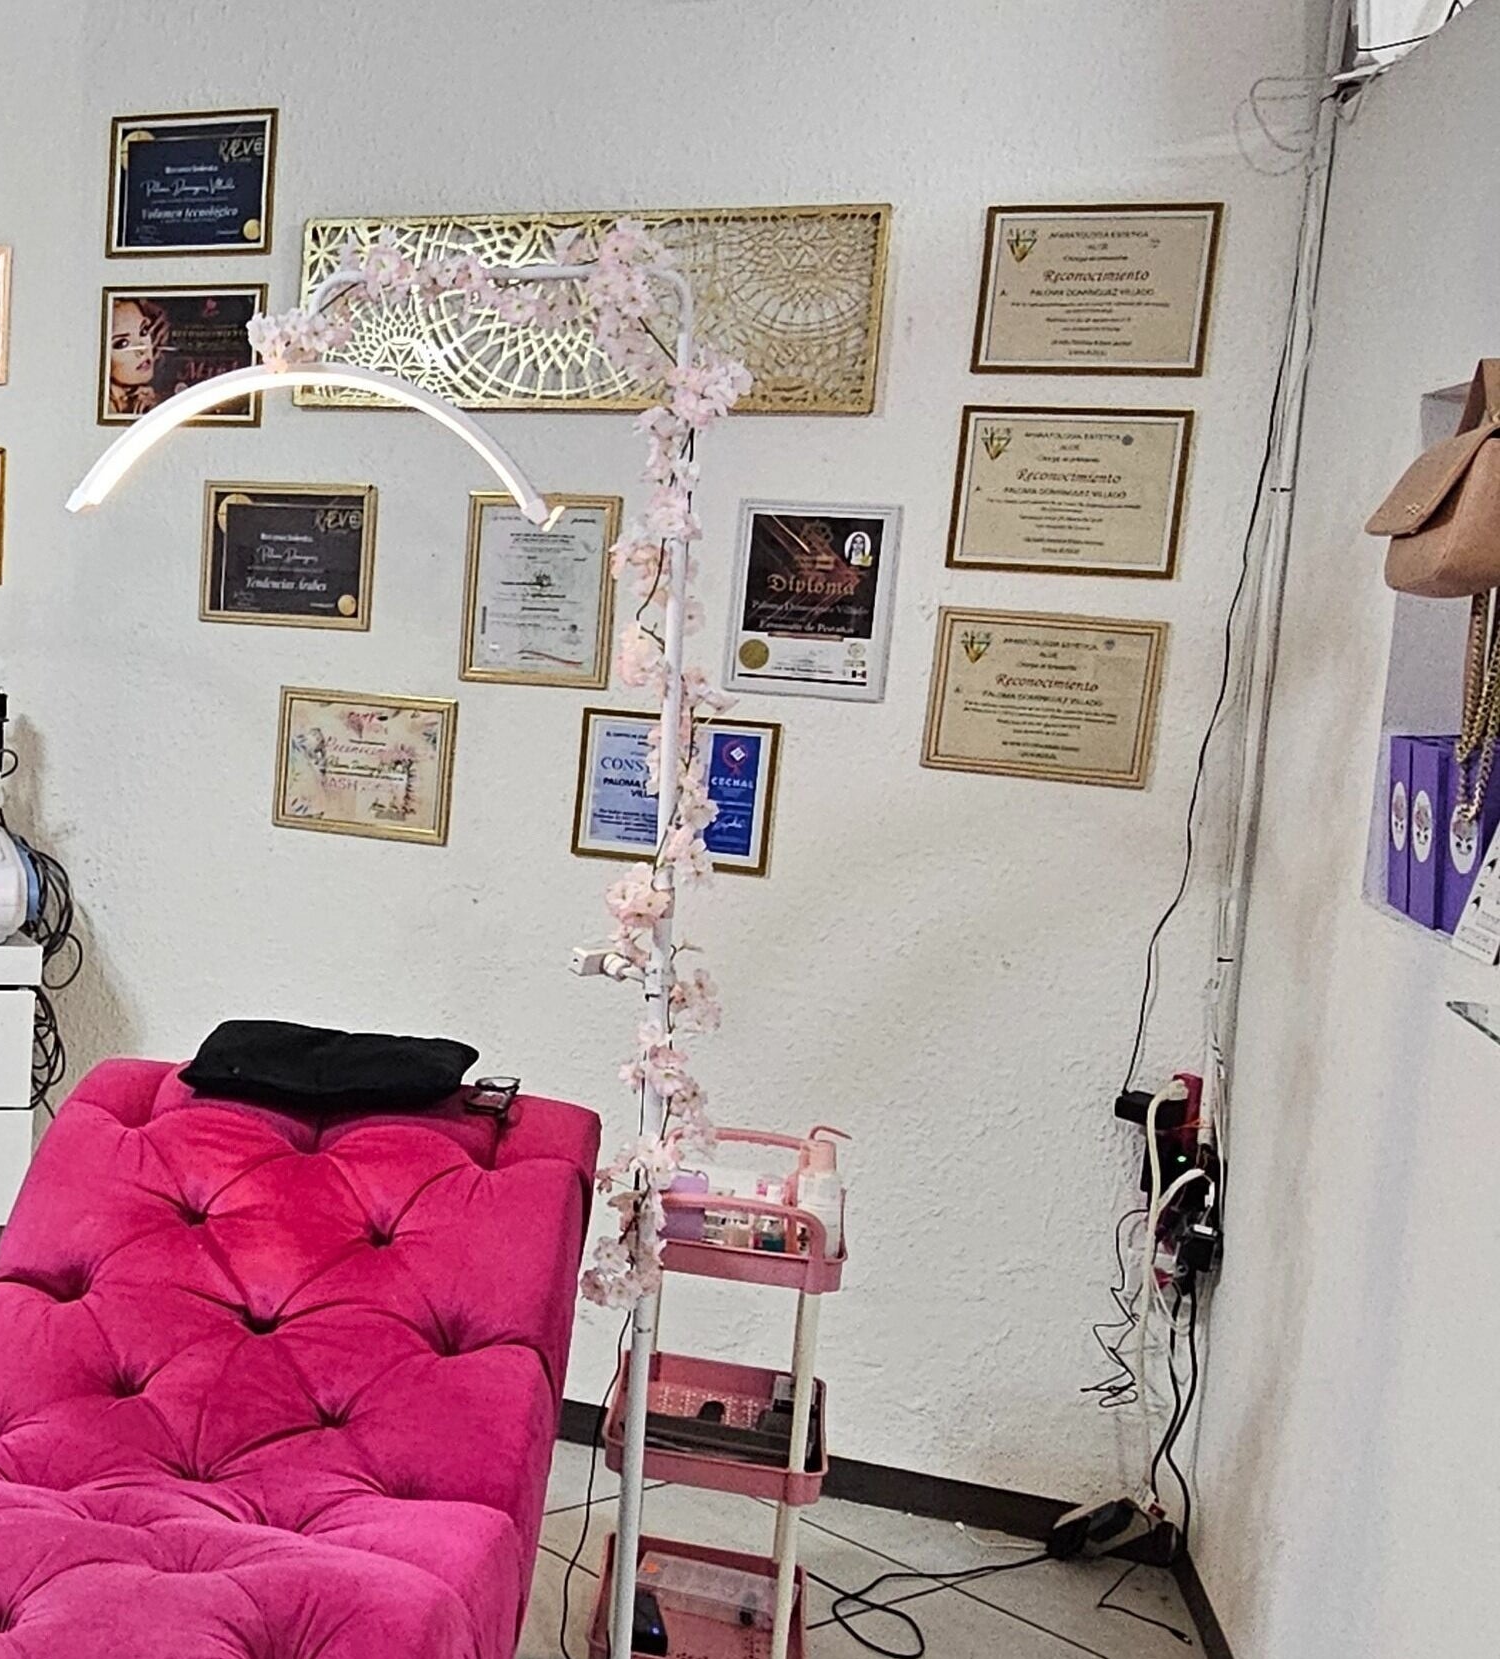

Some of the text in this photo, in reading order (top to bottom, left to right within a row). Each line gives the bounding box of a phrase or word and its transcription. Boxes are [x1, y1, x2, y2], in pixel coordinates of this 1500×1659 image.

[1043, 268, 1150, 284] Reconocimiento
[1016, 467, 1122, 485] Reconocimiento
[766, 573, 856, 596] Diploma
[995, 673, 1099, 692] Reconocimiento
